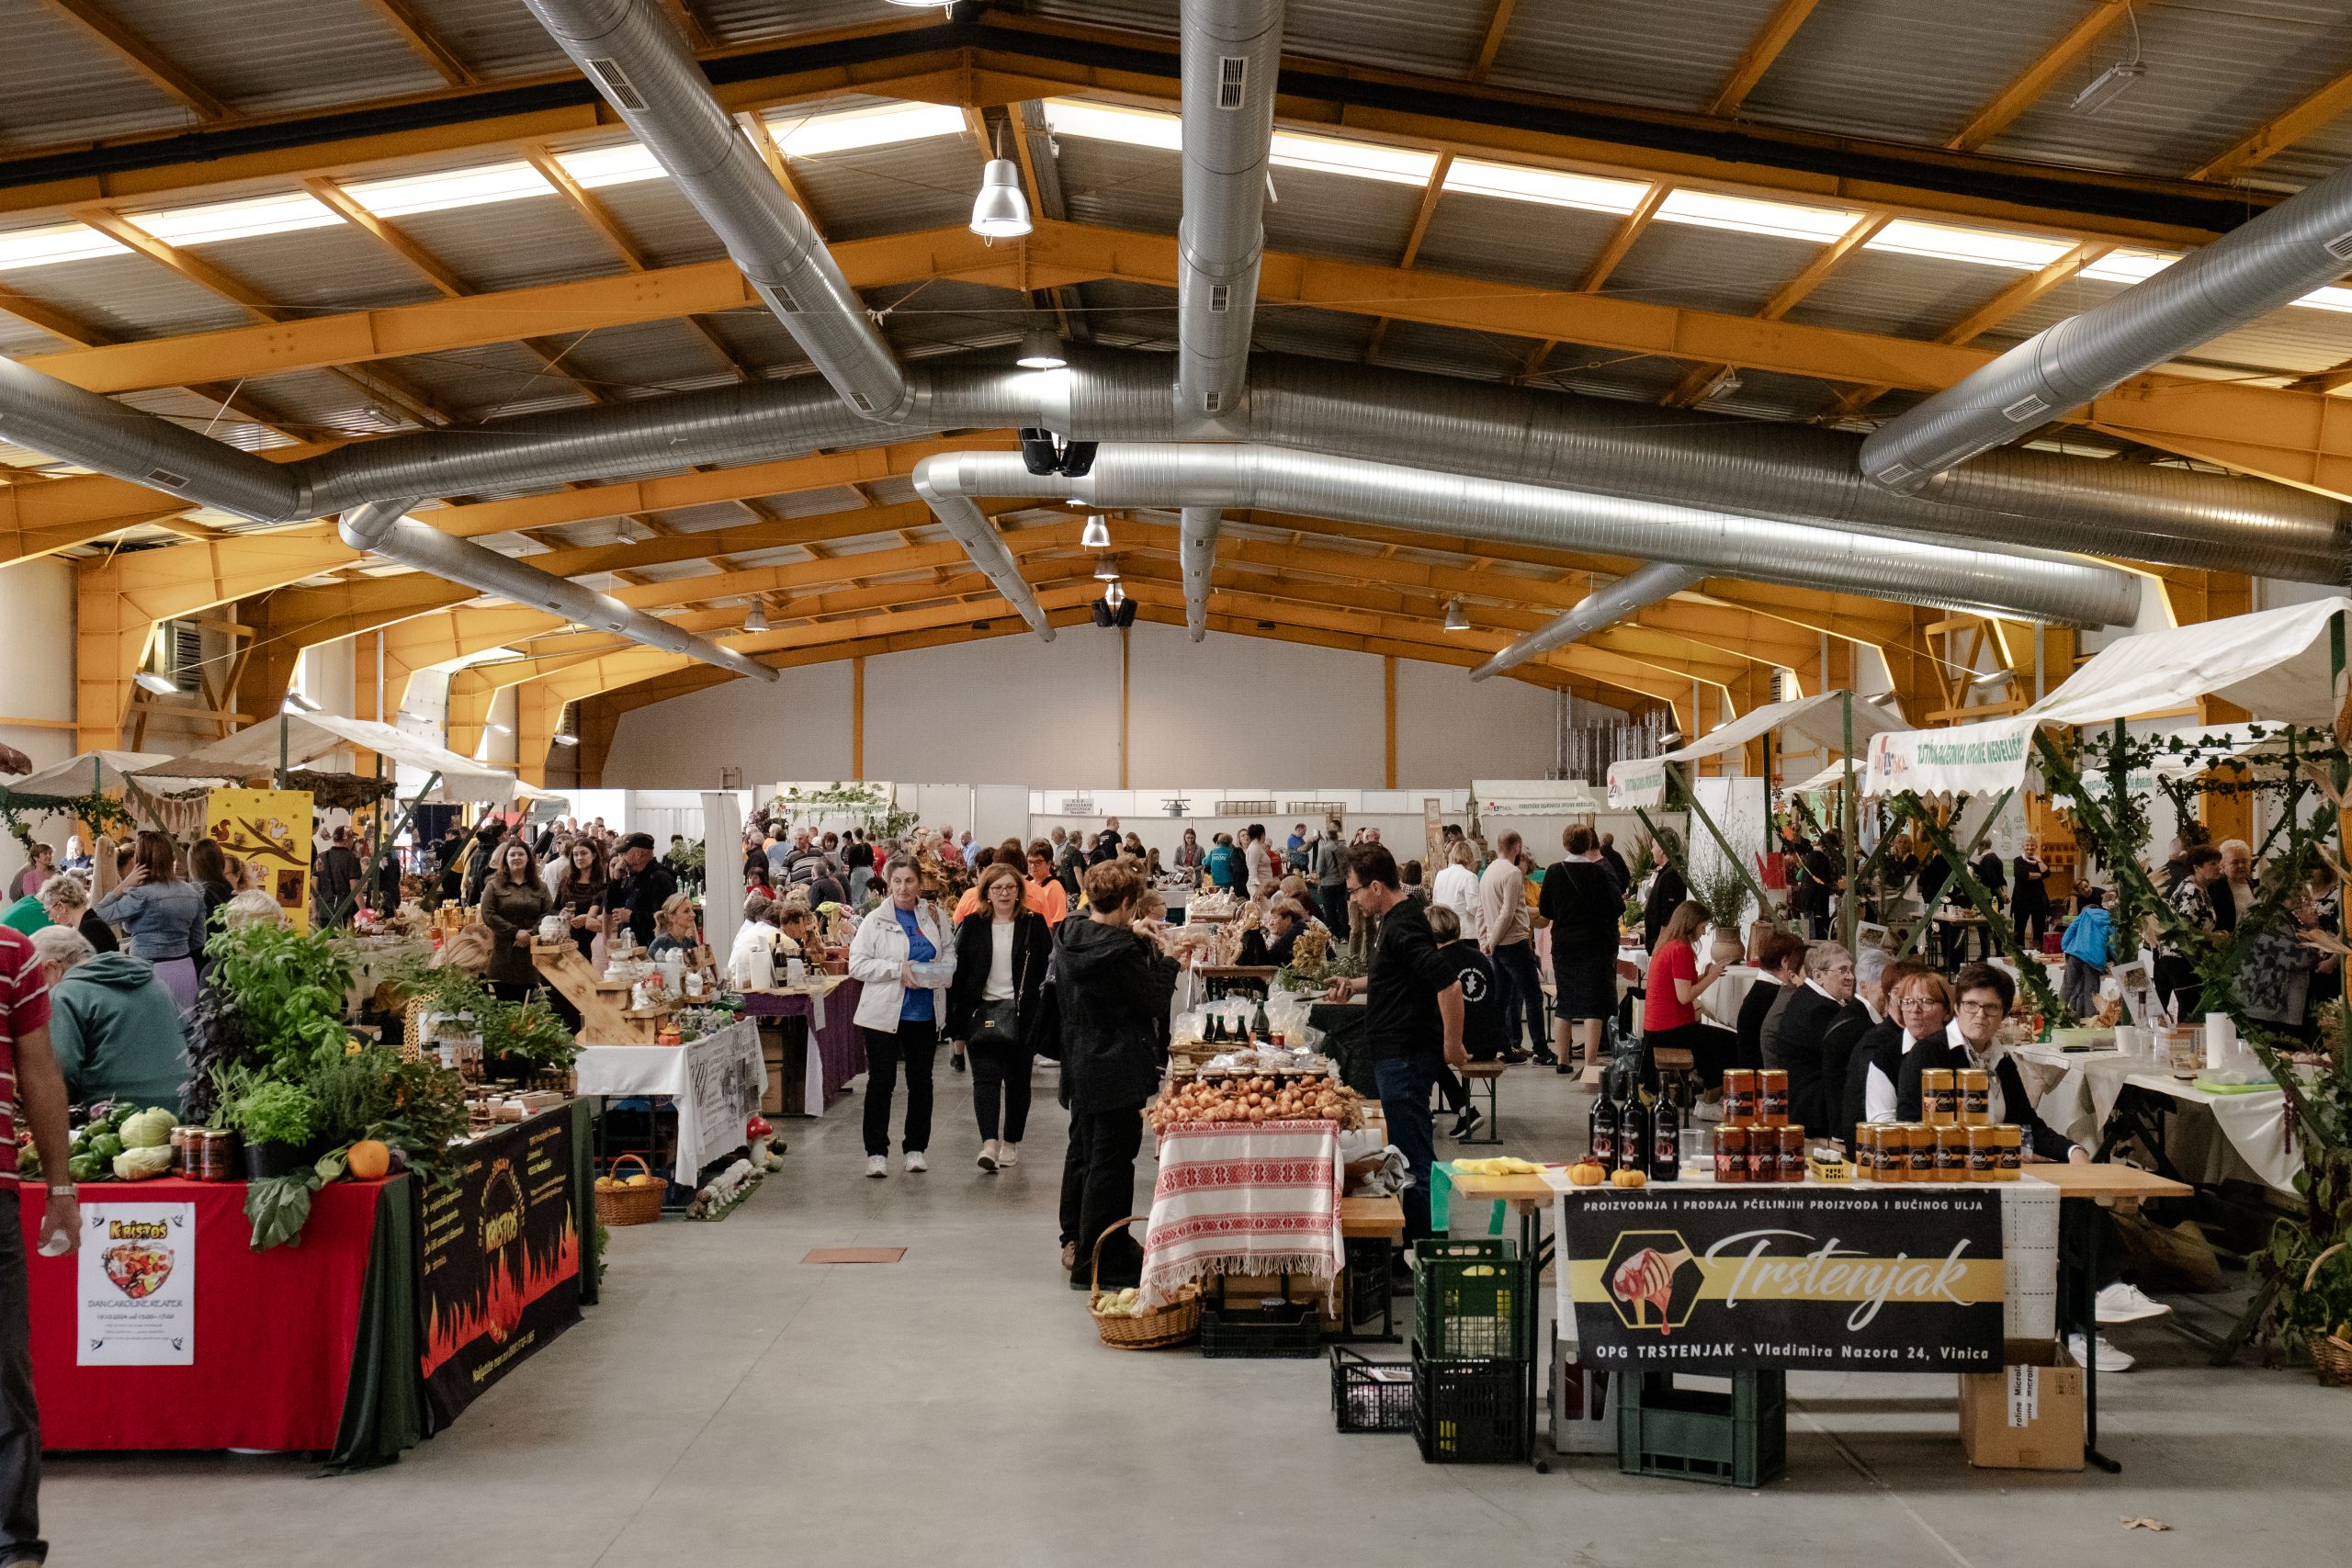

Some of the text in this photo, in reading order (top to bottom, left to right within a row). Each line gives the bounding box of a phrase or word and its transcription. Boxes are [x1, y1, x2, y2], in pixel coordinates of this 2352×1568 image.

[1584, 1199, 1983, 1212] PROIZVODNJA I PRODAJA PČELINJIH PROIZVODA I BUČINOG ULJA
[1704, 1229, 1975, 1332] Trstenjak
[1596, 1346, 1628, 1359] OPG
[1637, 1343, 1735, 1359] TRSTENJAK
[1754, 1343, 1833, 1358] Vladimira
[1841, 1346, 1898, 1359] Nazora
[1907, 1347, 1929, 1360] 24,
[1940, 1346, 1989, 1359] Vinica
